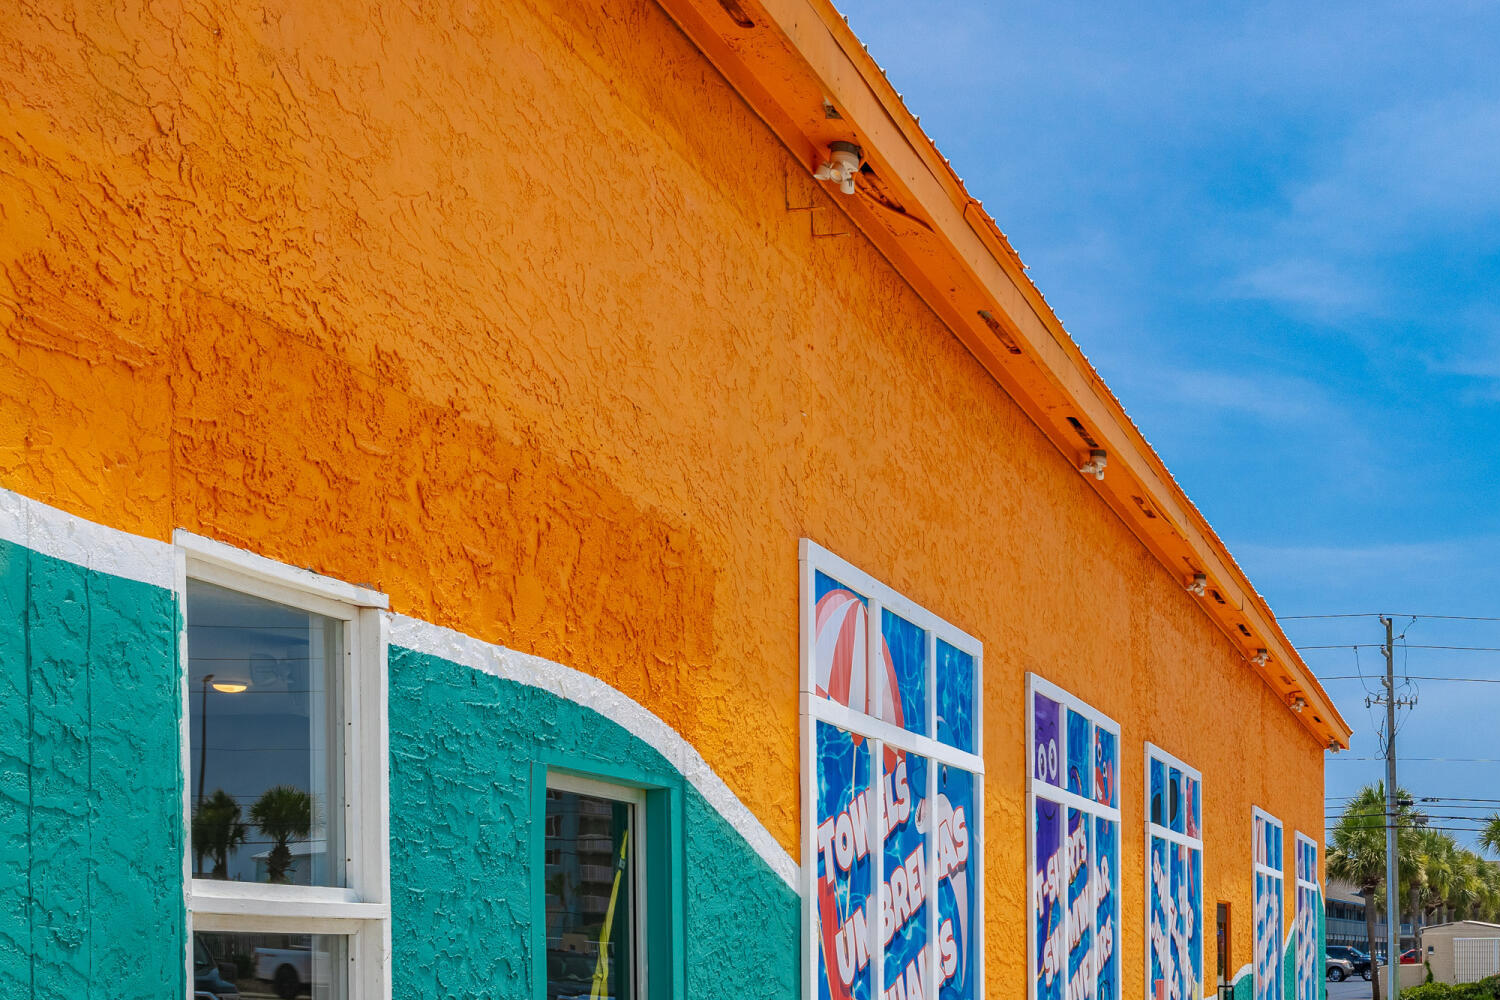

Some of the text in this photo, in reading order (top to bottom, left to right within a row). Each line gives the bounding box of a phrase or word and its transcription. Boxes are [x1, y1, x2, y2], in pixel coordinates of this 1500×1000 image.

[817, 759, 911, 886] TOWLS
[1036, 818, 1087, 918] T-SHRTS
[834, 805, 969, 987] UMBRELAS
[1043, 854, 1111, 987] SWMWAR
